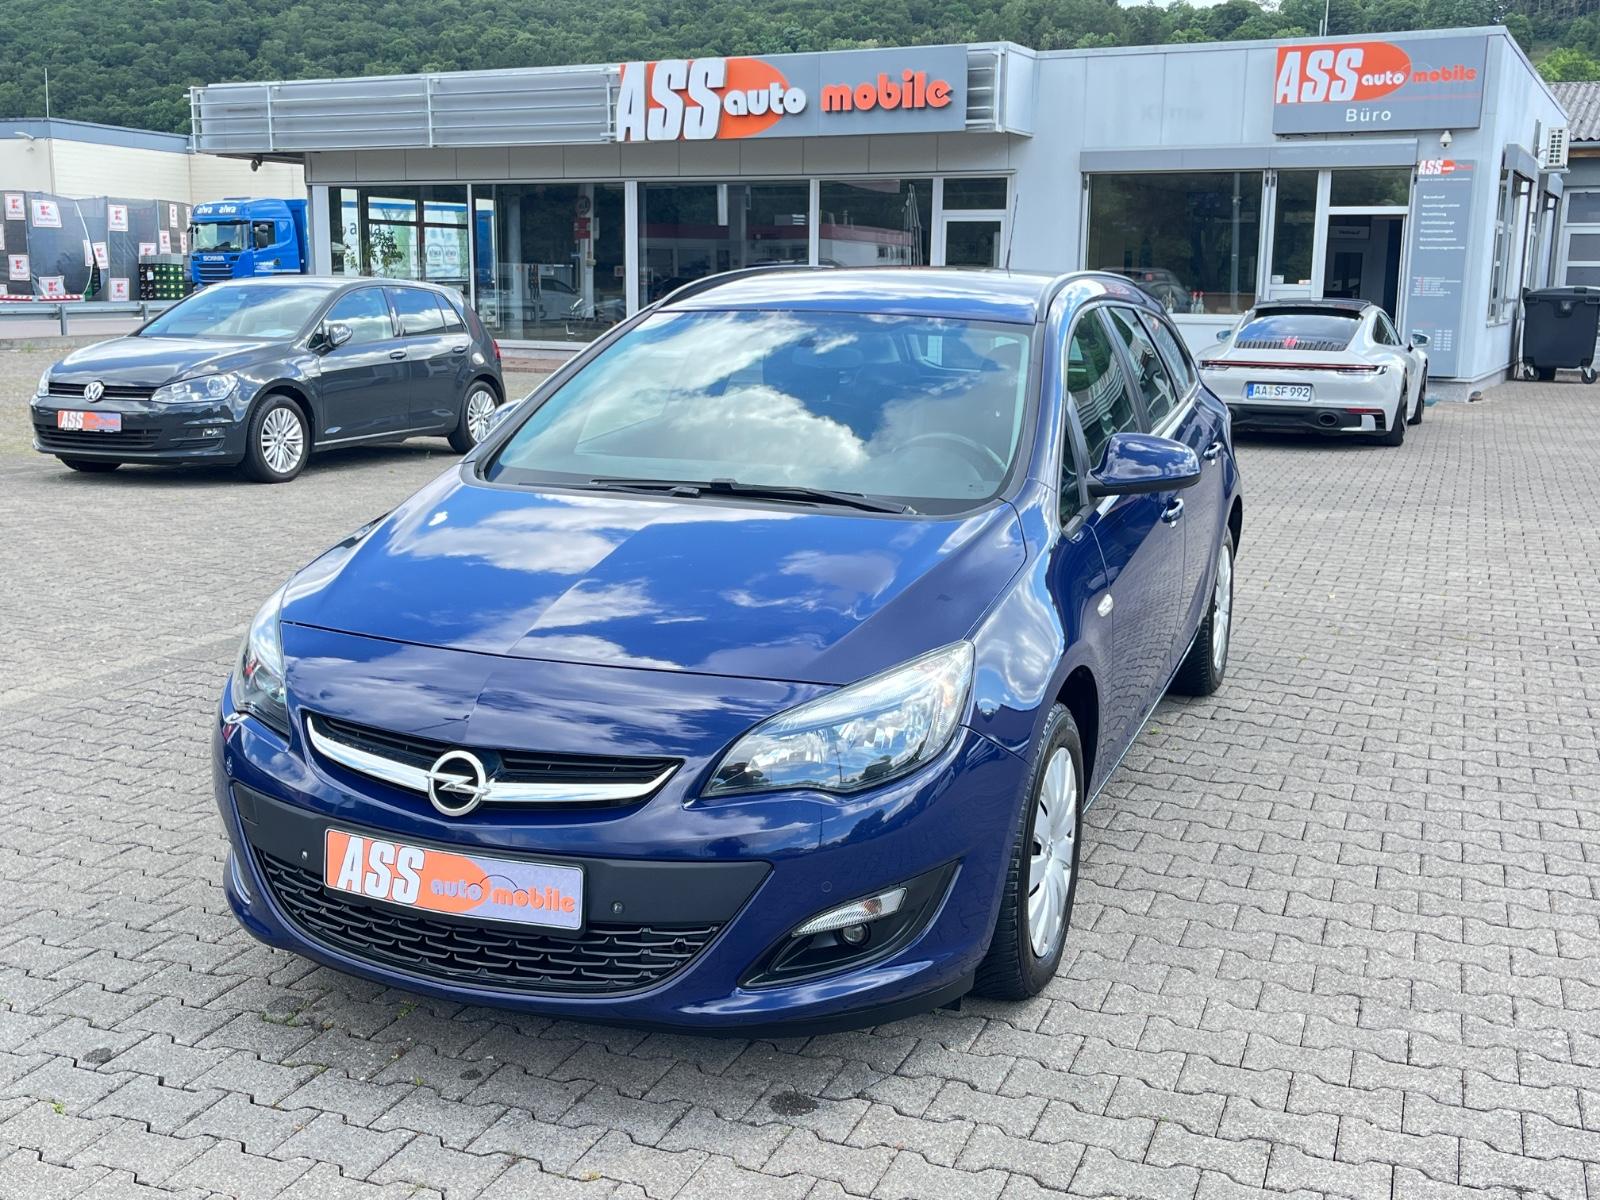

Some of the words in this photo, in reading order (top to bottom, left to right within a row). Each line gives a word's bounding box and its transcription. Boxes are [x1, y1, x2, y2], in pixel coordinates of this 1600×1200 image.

[1276, 48, 1364, 104] ASS
[1361, 69, 1405, 86] auto
[1412, 64, 1478, 83] mobile
[615, 57, 727, 142] ASS
[723, 82, 807, 117] auto
[820, 68, 953, 113] mobile
[1345, 107, 1391, 122] Büro
[1418, 160, 1443, 175] ASS
[1254, 385, 1267, 396] AA
[1274, 385, 1288, 396] SF
[1290, 386, 1310, 398] 992
[60, 411, 84, 429] ASS
[336, 836, 425, 904] ASS
[431, 878, 482, 900] auto
[492, 887, 576, 913] mobile
